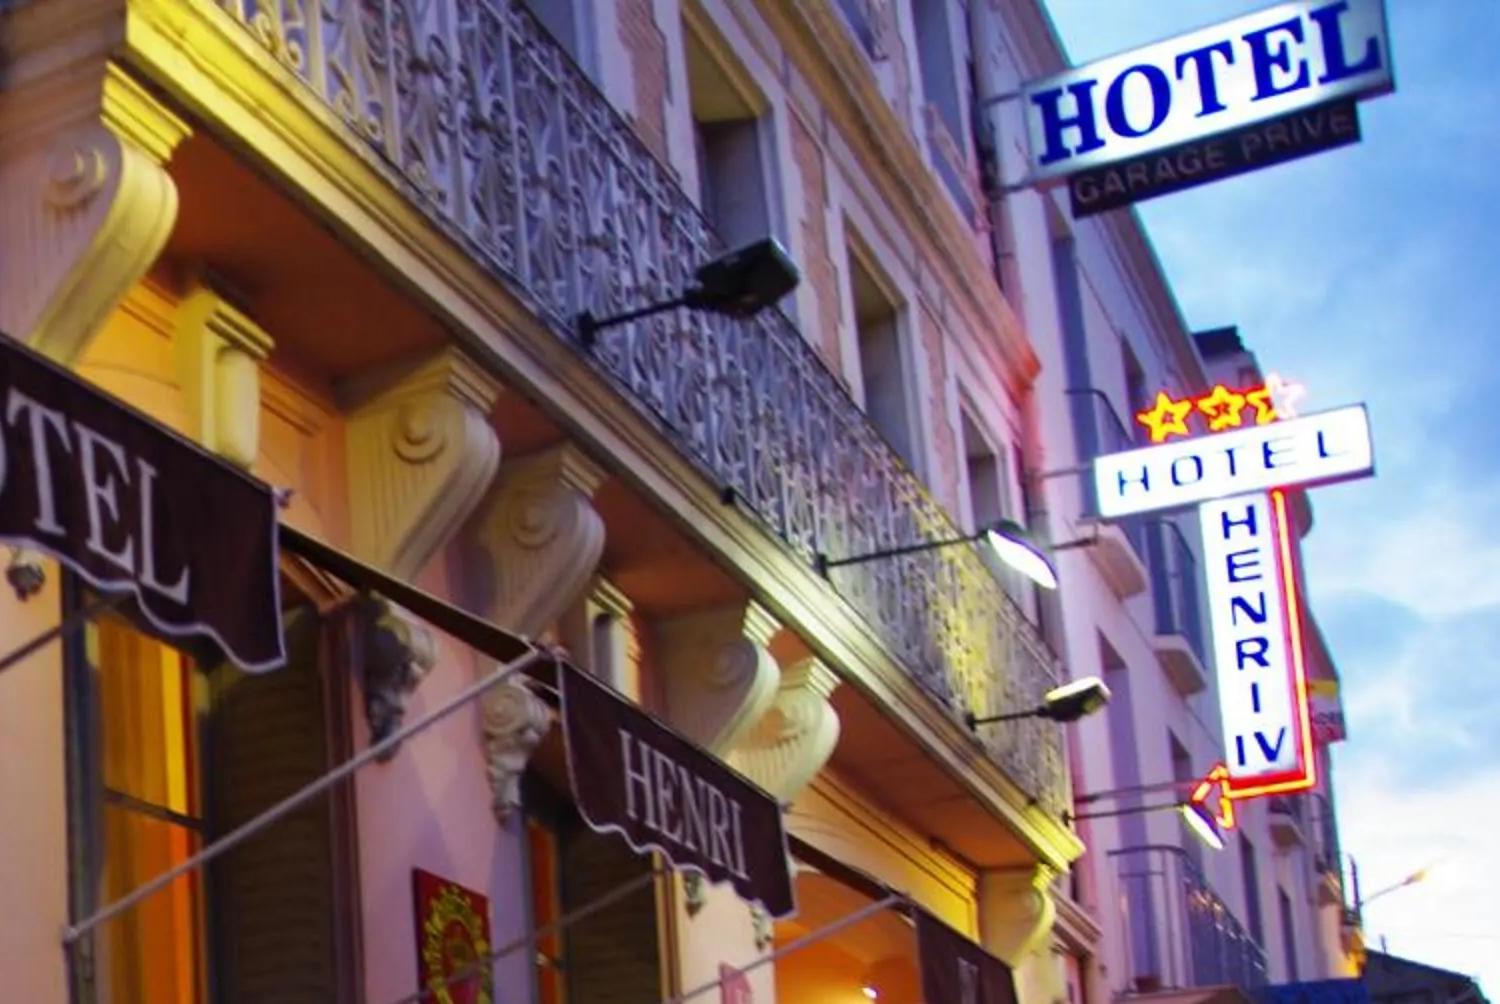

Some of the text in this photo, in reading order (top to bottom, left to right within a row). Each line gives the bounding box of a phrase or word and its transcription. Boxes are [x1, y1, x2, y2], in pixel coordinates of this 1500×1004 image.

[1031, 1, 1382, 166] HOTEL
[1074, 143, 1227, 204] GARAGE
[1117, 430, 1348, 497] HOTEL
[1221, 504, 1270, 714] HENRI
[618, 728, 750, 881] HENRI
